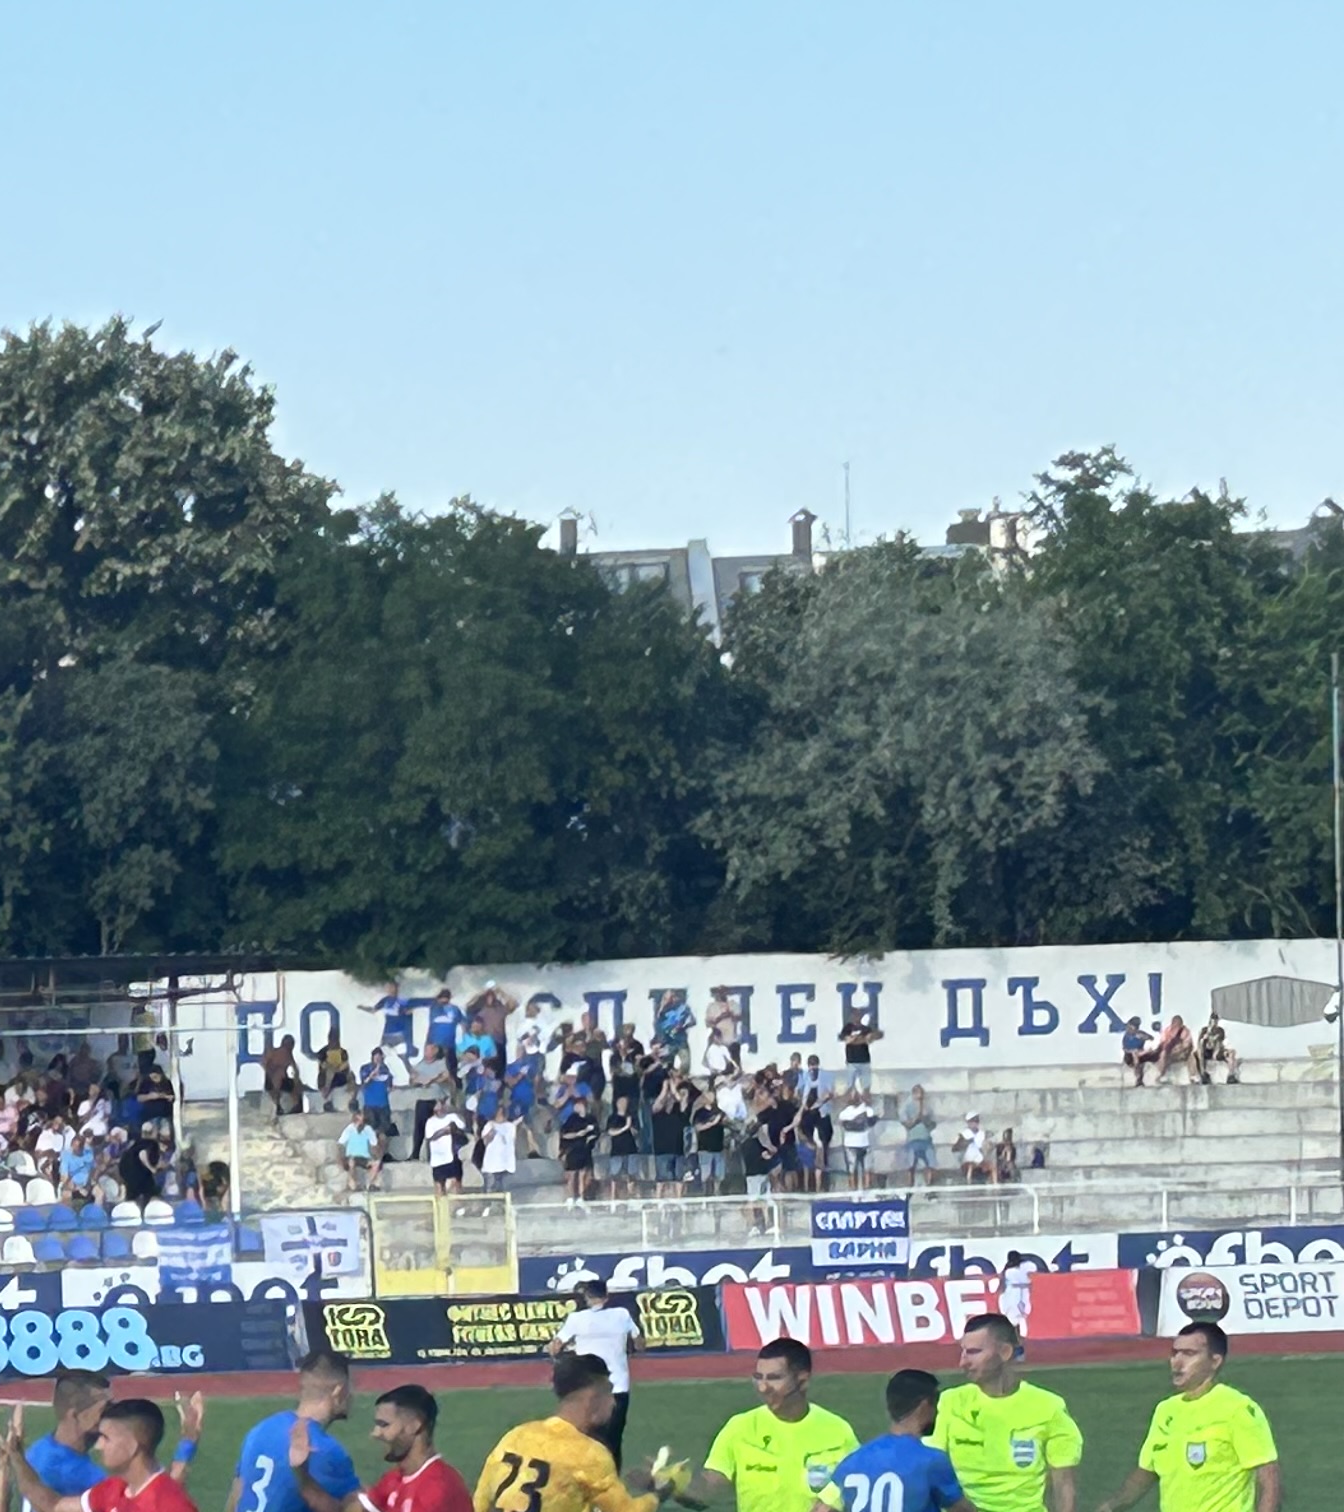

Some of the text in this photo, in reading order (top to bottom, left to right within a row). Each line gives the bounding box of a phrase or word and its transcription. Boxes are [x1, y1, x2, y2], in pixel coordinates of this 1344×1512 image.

[939, 972, 1163, 1048] ДЪХ!
[1239, 1271, 1336, 1295] SPORT
[744, 1279, 1002, 1350] WINBE
[1243, 1296, 1339, 1320] DEPOT
